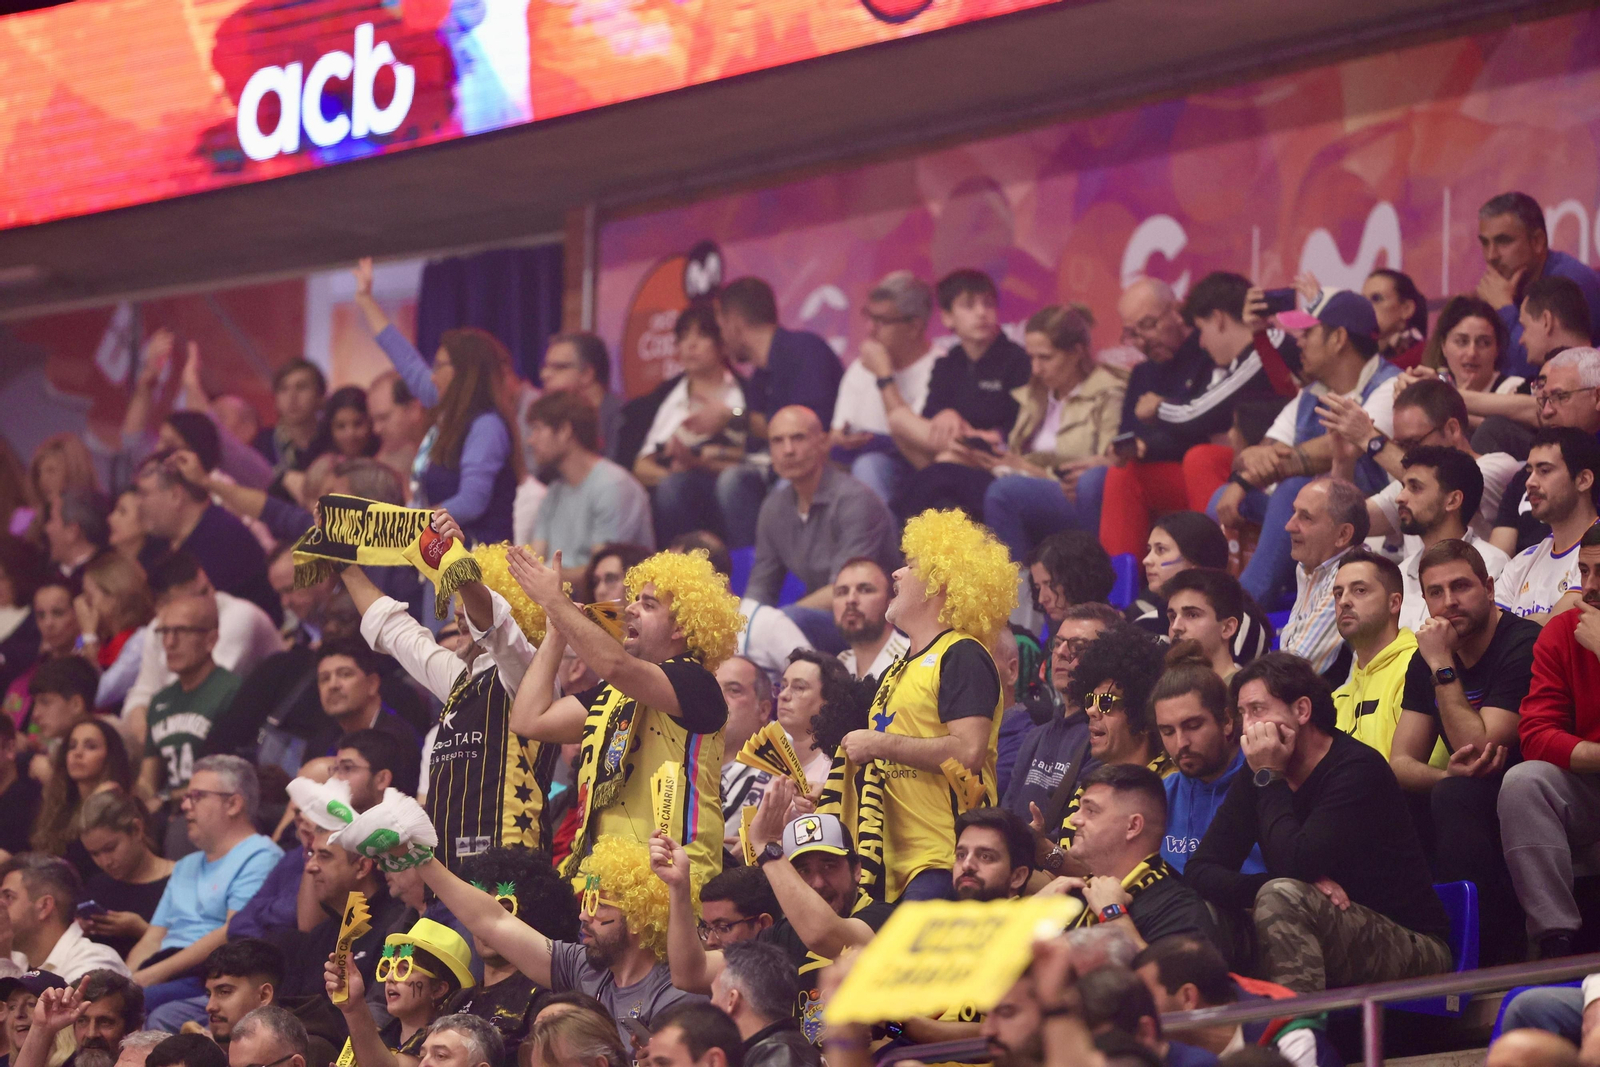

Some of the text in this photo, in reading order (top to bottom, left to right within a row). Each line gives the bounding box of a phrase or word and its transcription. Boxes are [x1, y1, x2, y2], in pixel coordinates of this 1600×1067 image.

[236, 21, 416, 161] acb
[324, 505, 426, 548] VAMOS CANARIAS
[779, 734, 804, 778] CANARIAS!
[886, 769, 918, 780] SORTS
[662, 775, 675, 822] CANARIAS!
[408, 980, 424, 999] 19
